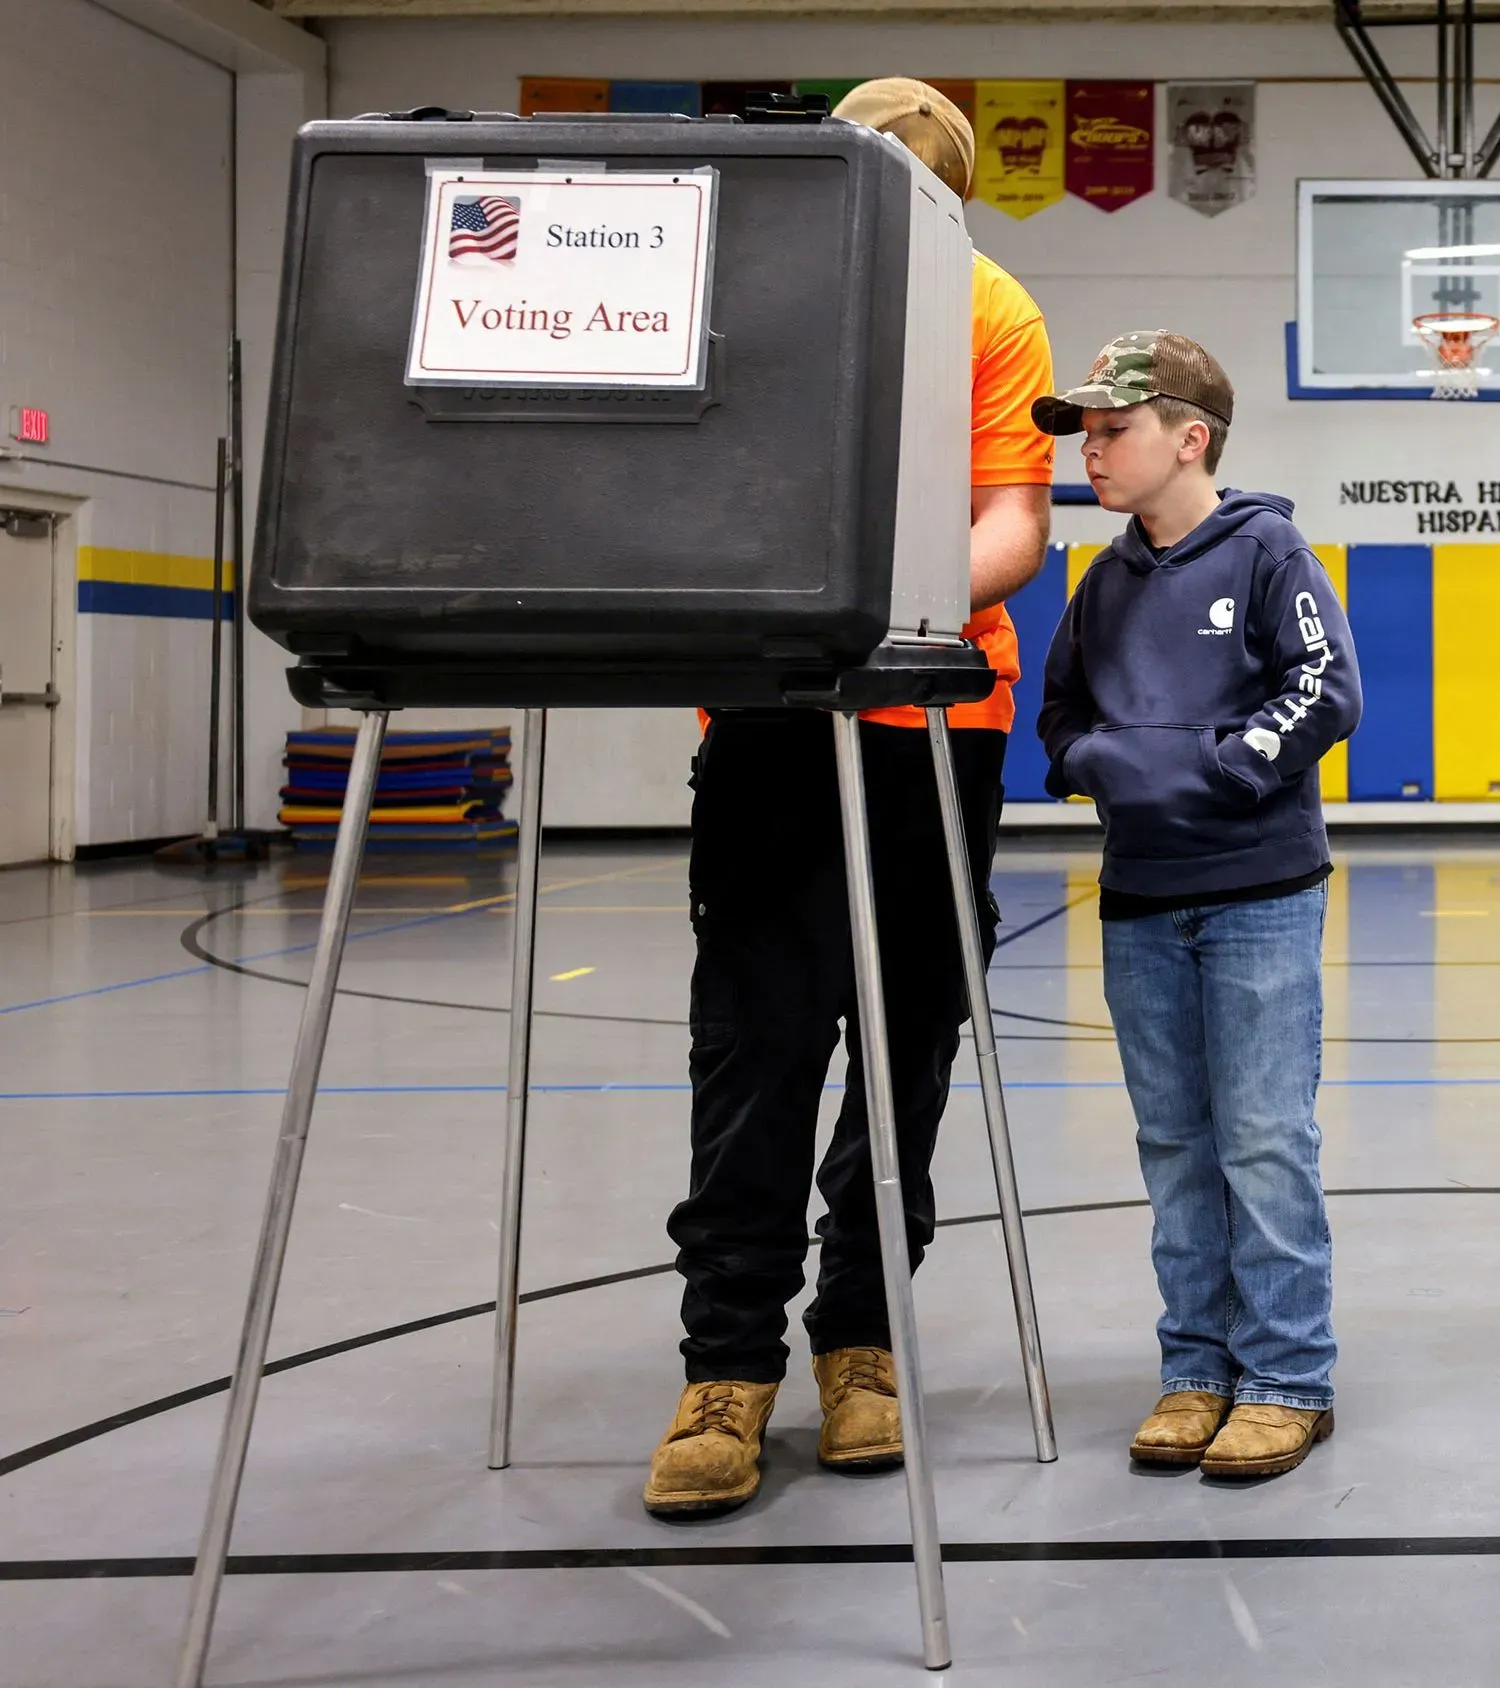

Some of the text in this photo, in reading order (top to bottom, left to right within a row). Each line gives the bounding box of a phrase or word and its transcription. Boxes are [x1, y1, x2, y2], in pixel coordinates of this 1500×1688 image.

[546, 224, 664, 249] Station 3
[451, 299, 670, 340] Voting Area
[22, 407, 49, 442] EXIT
[1339, 480, 1463, 505] NUESTRA
[1272, 591, 1334, 734] carhartt
